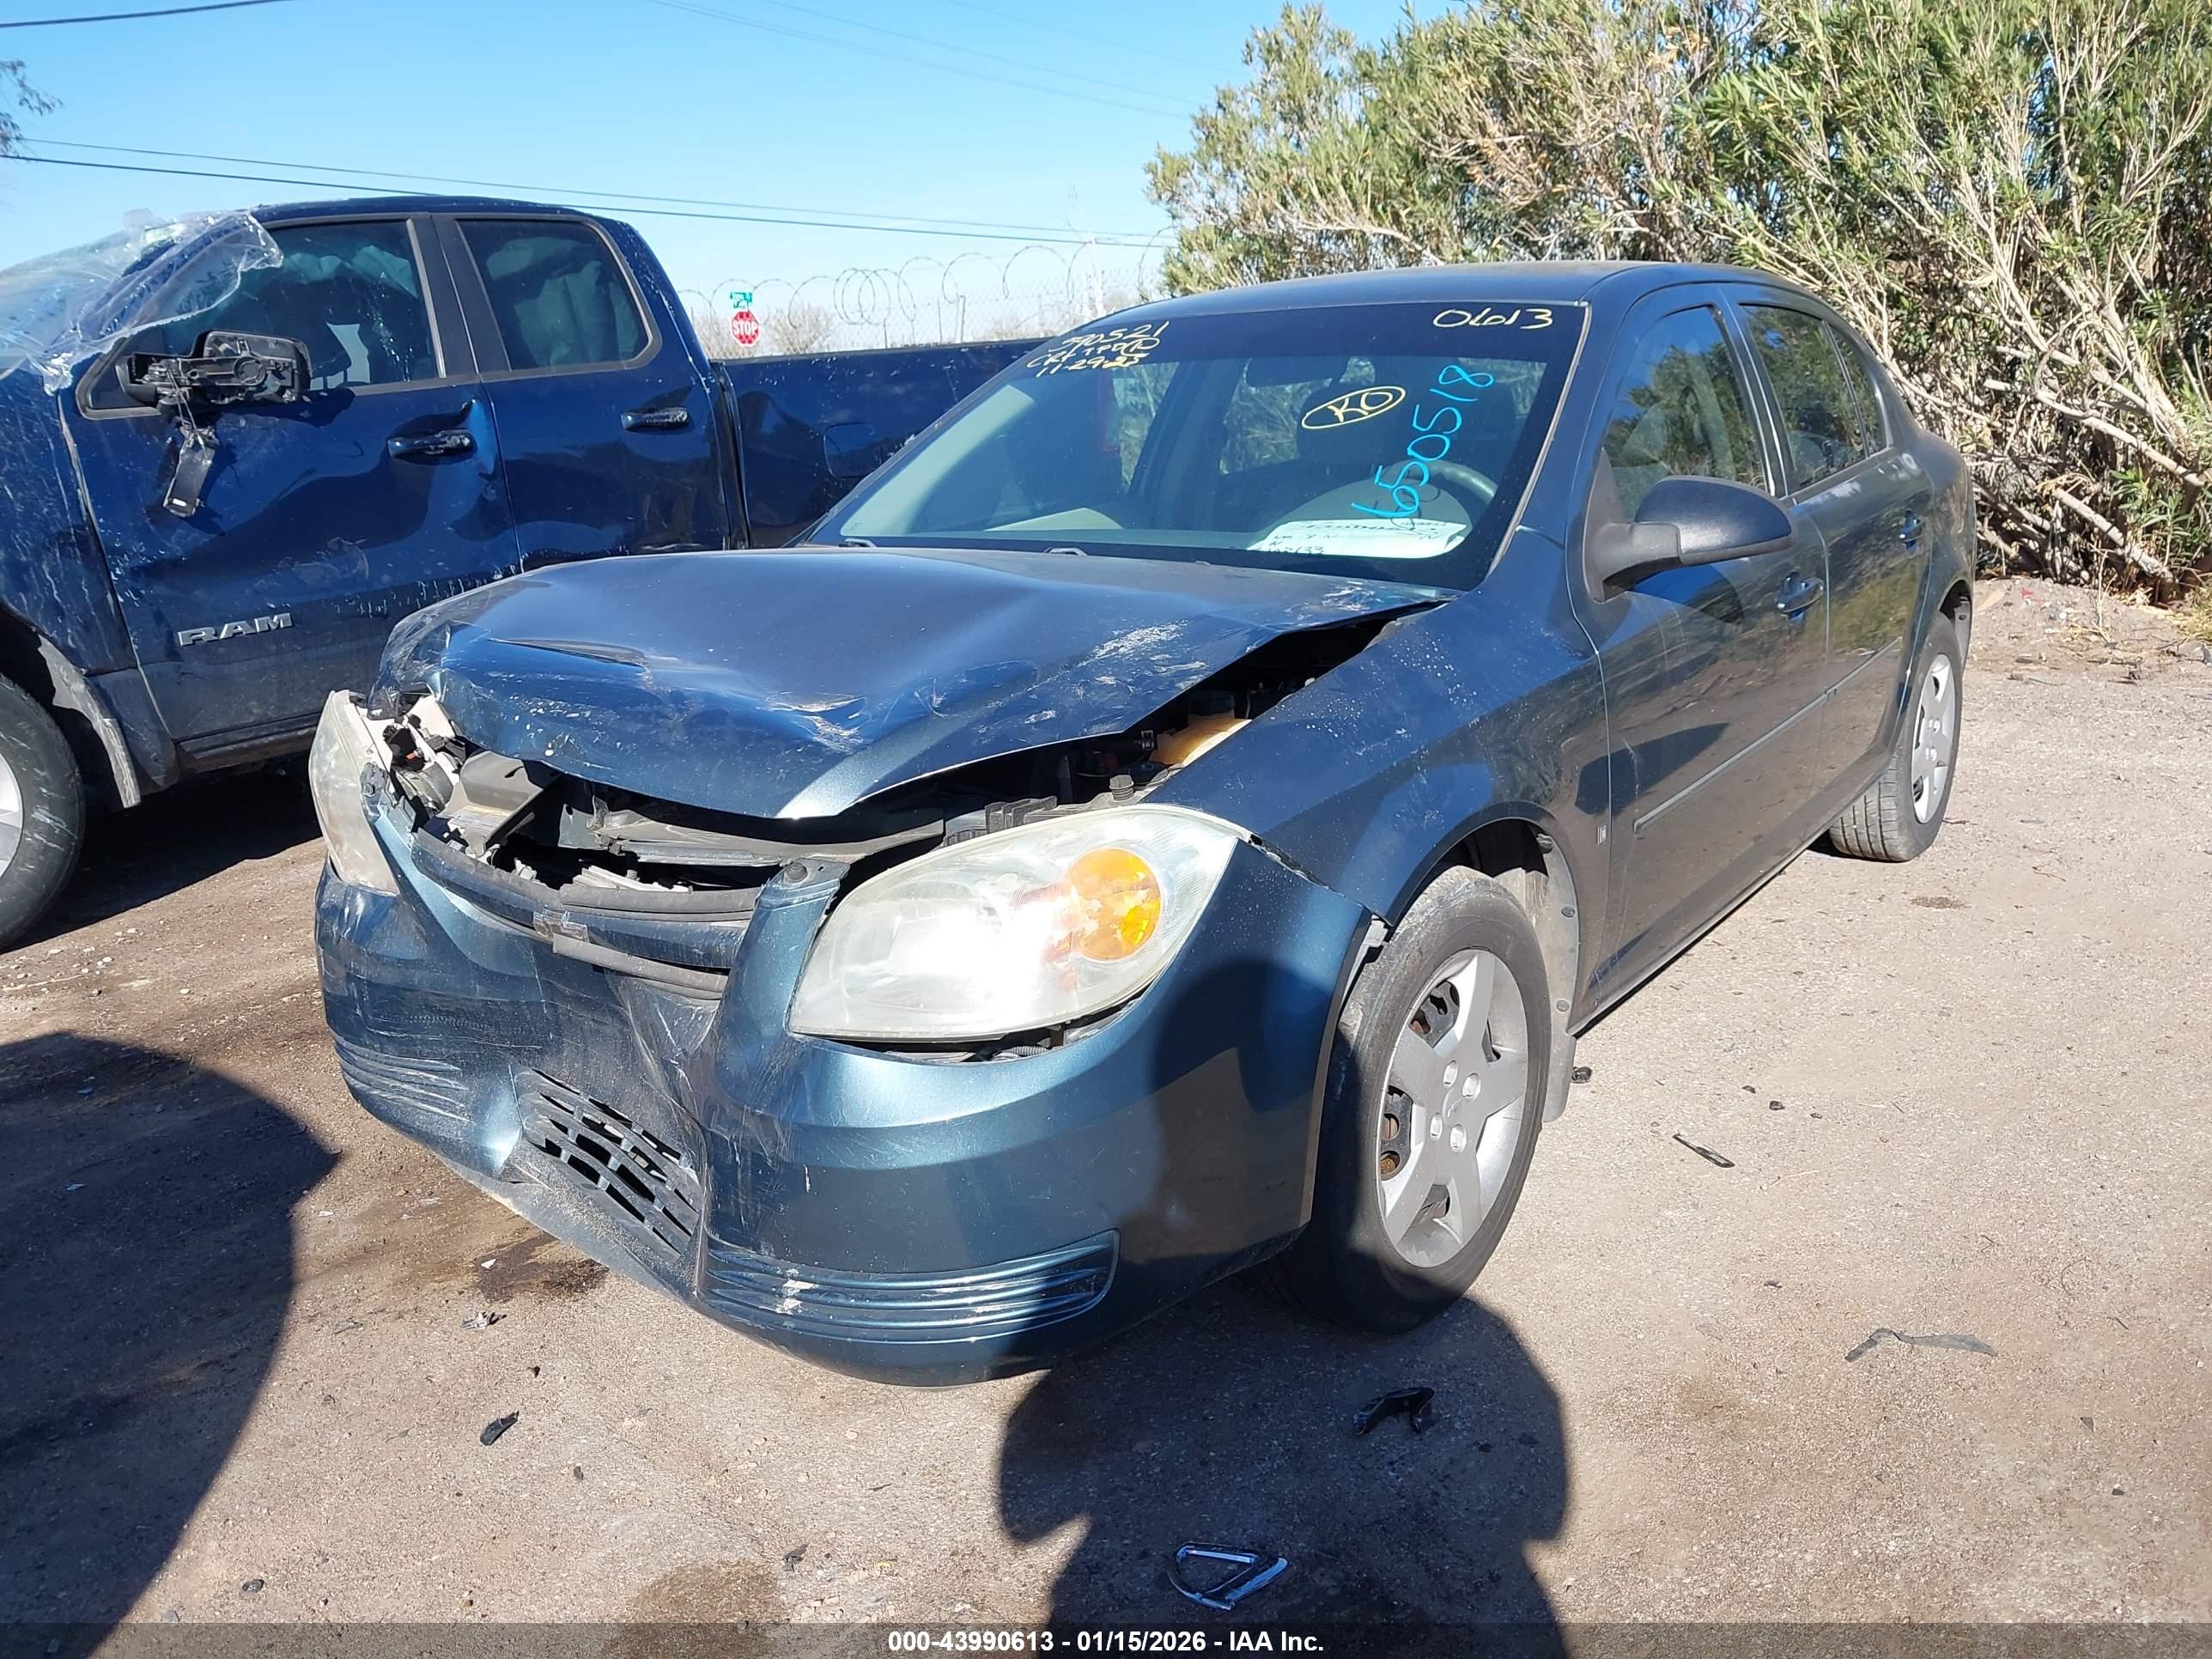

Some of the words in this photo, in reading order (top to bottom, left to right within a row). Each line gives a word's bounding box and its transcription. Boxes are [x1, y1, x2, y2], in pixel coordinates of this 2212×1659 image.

[732, 319, 758, 336] STOP
[1432, 308, 1553, 329] 0613
[1351, 364, 1495, 519] 650518
[177, 612, 293, 646] RAM
